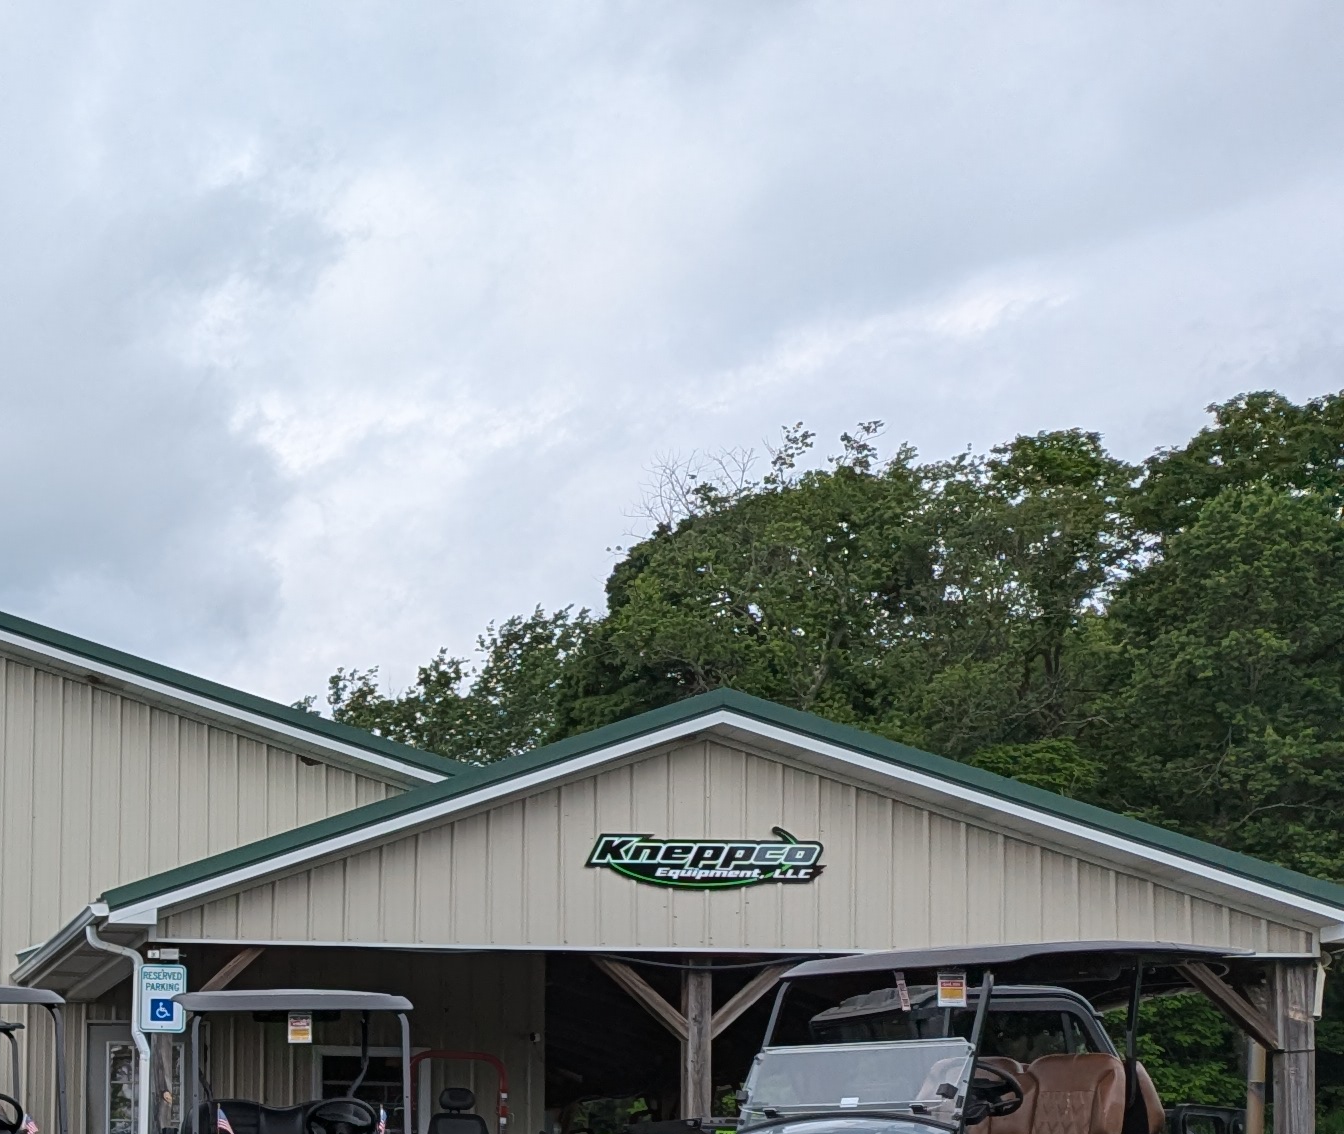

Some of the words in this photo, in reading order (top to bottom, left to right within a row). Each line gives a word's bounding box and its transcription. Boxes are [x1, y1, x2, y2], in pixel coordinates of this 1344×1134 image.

[591, 837, 821, 869] Kneppco
[654, 866, 764, 880] Equipment,
[773, 868, 813, 879] LLC
[142, 971, 182, 981] RESERVED
[145, 982, 180, 992] PARKING
